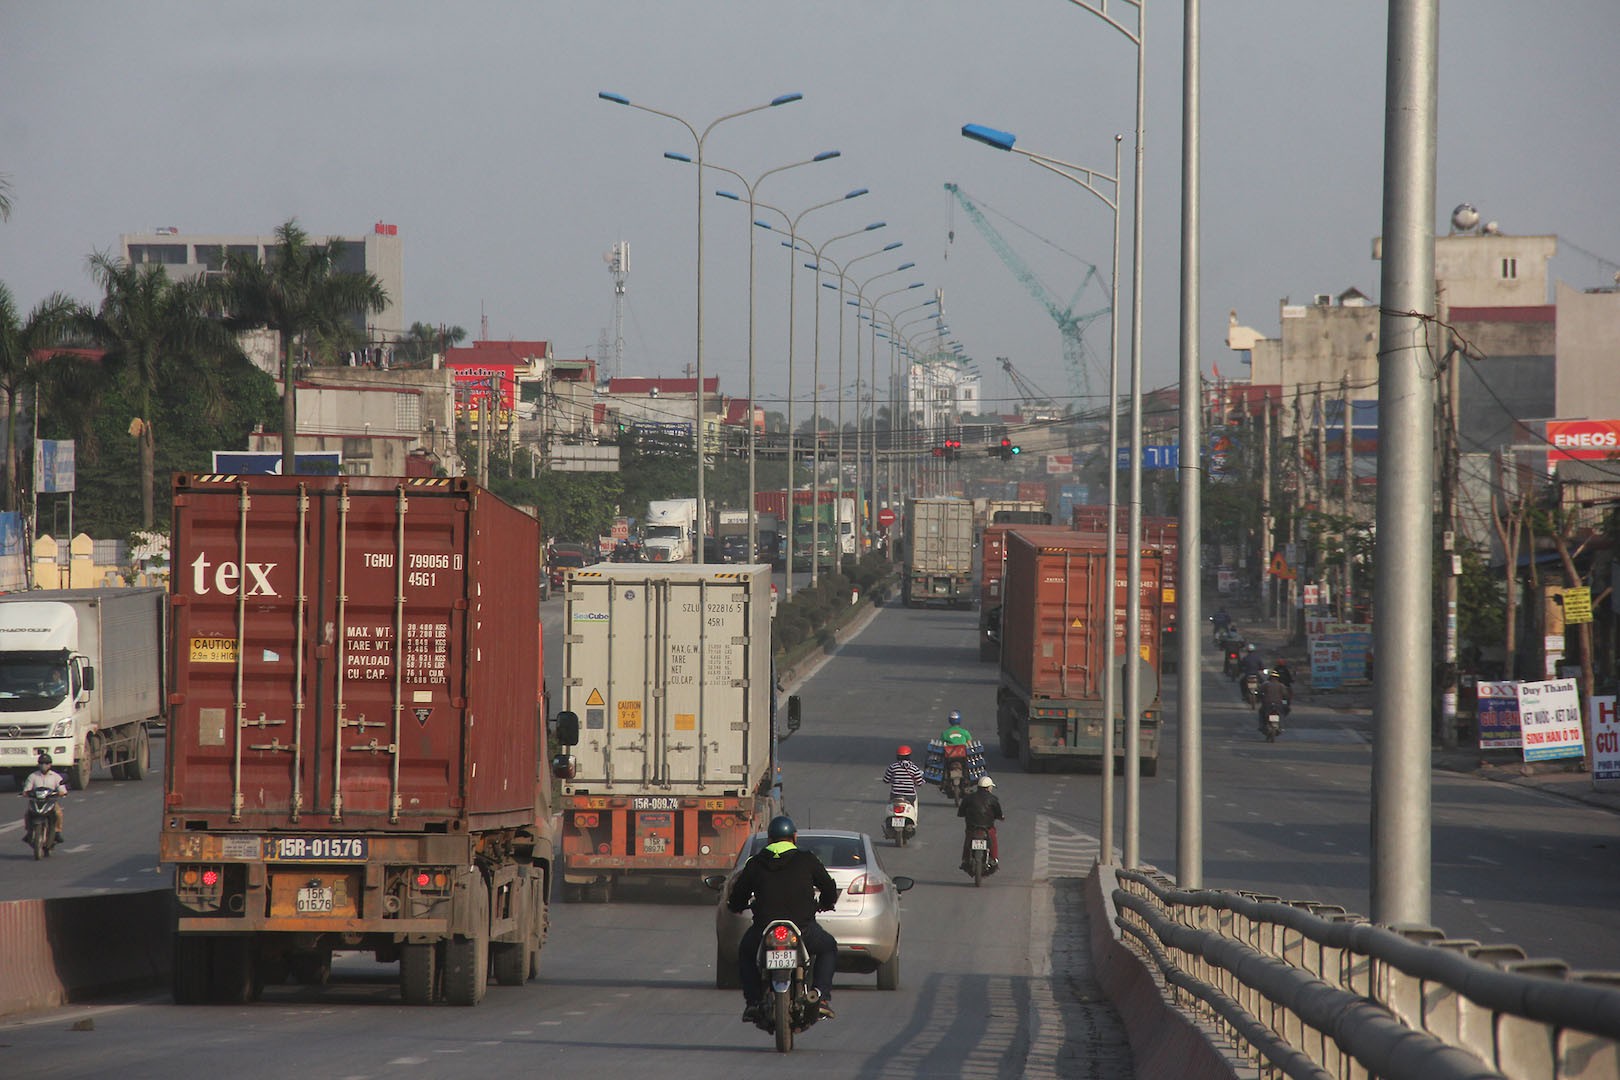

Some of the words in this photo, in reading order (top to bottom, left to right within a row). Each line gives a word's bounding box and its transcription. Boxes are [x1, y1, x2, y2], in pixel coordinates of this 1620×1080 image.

[454, 367, 505, 378] uilding
[1555, 432, 1617, 448] ENEOS
[364, 553, 393, 568] TGHU
[409, 554, 449, 569] 799056
[408, 572, 436, 586] 45G1
[682, 604, 700, 613] SZLU
[707, 603, 734, 613] 922816
[737, 603, 742, 613] 5
[573, 612, 609, 620] SeaCube
[435, 623, 447, 631] KGS
[707, 618, 724, 627] 45R1
[347, 627, 371, 637] MAX.
[375, 627, 393, 637] WT.
[195, 639, 239, 649] CAUTION
[347, 640, 371, 651] TARE
[375, 640, 393, 651] WT.
[347, 655, 390, 666] PAYLOAD
[347, 668, 363, 679] CU.
[366, 669, 388, 679] CAP.
[1522, 686, 1541, 696] Duy
[617, 701, 641, 710] CAUTION
[622, 720, 636, 728] HIGH
[634, 798, 679, 810] 15R-089.74
[279, 838, 362, 857] 15R-015.76
[307, 888, 324, 899] 15R
[771, 951, 793, 960] 15-B1
